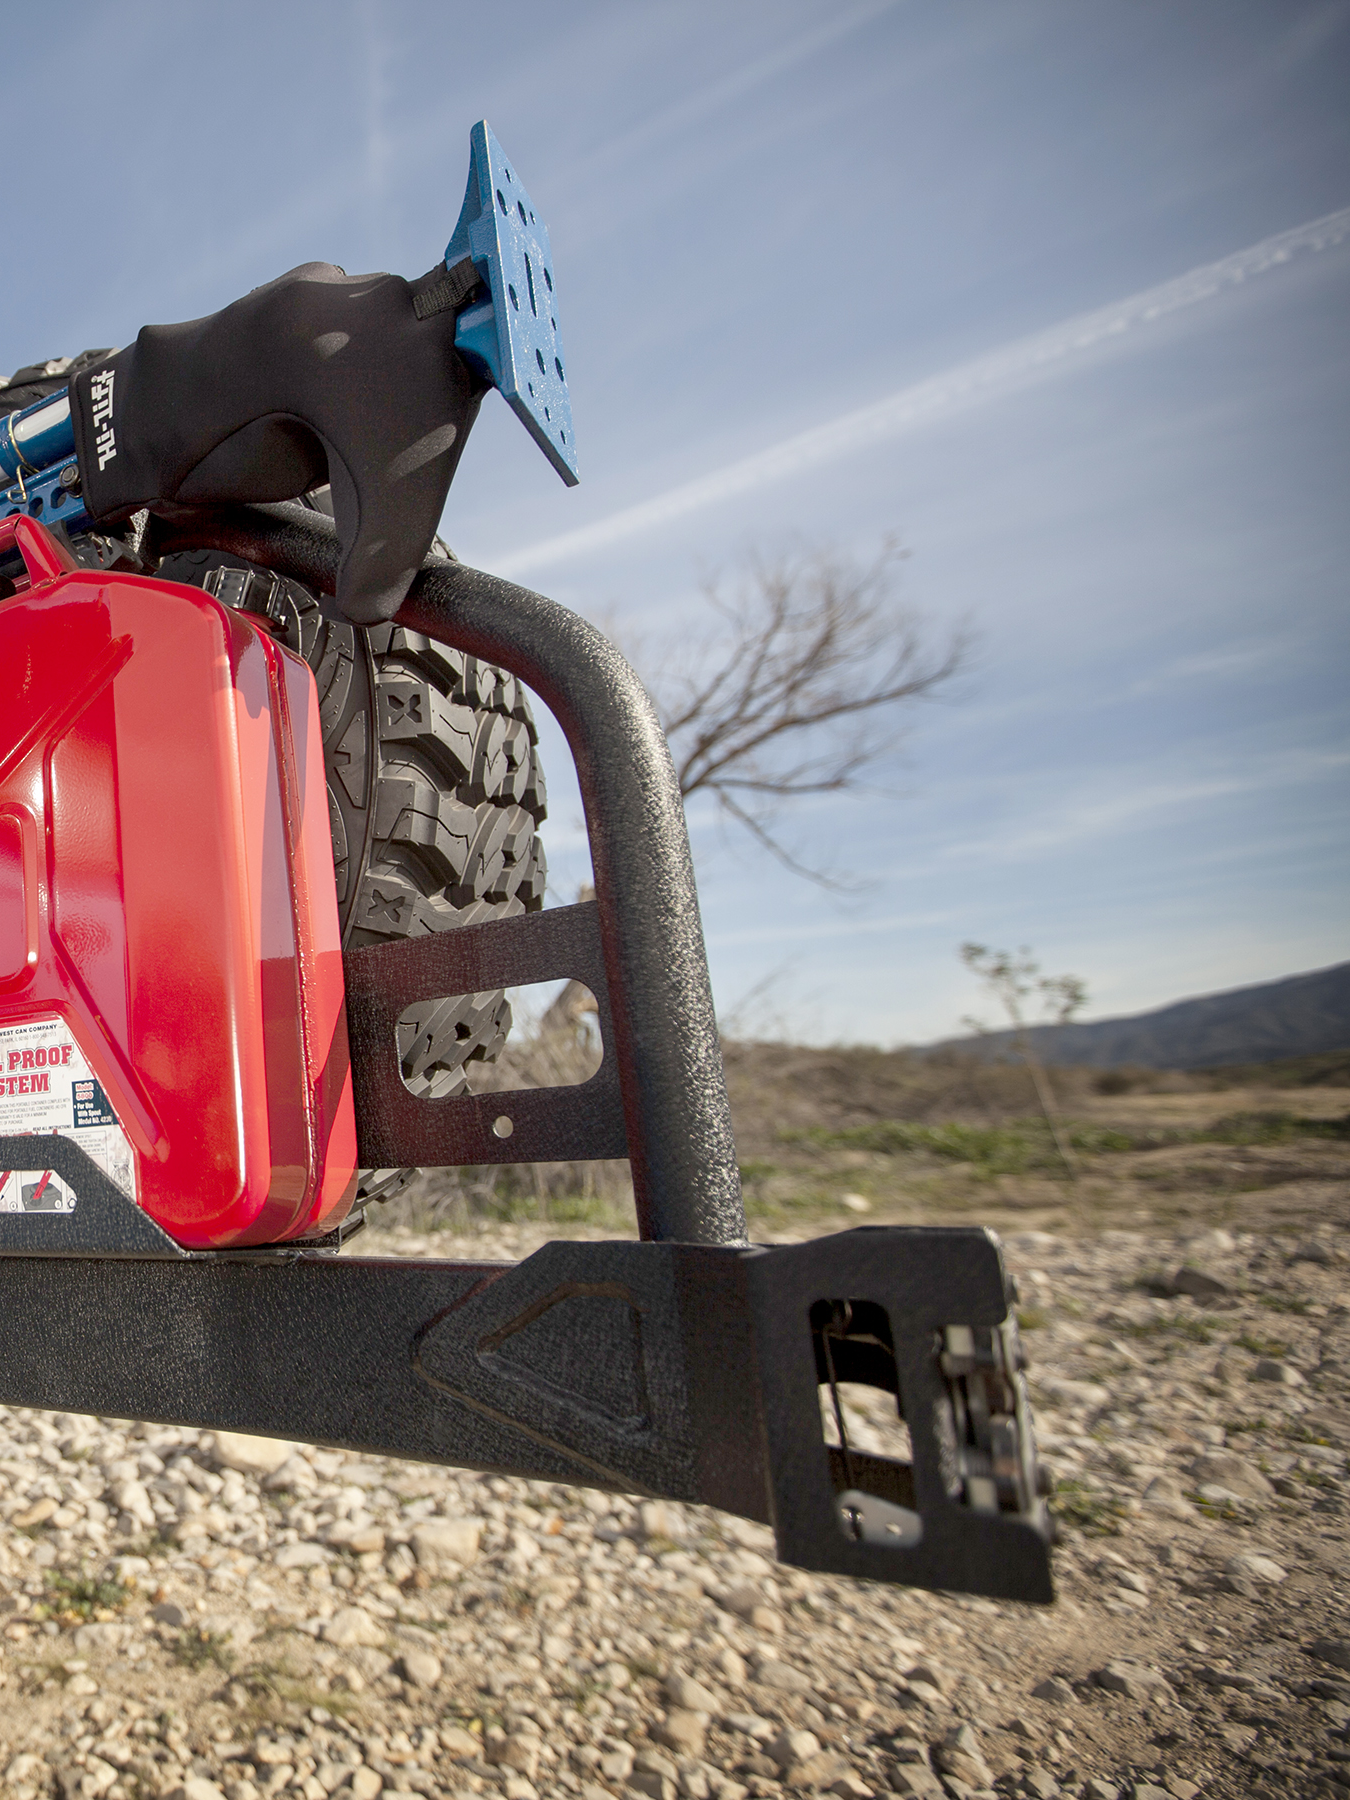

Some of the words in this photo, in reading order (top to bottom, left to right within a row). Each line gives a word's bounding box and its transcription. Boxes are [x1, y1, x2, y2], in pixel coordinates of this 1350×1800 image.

[91, 370, 117, 472] Hi-Lift
[29, 1024, 57, 1033] COMPANY
[8, 1045, 73, 1069] PROOF
